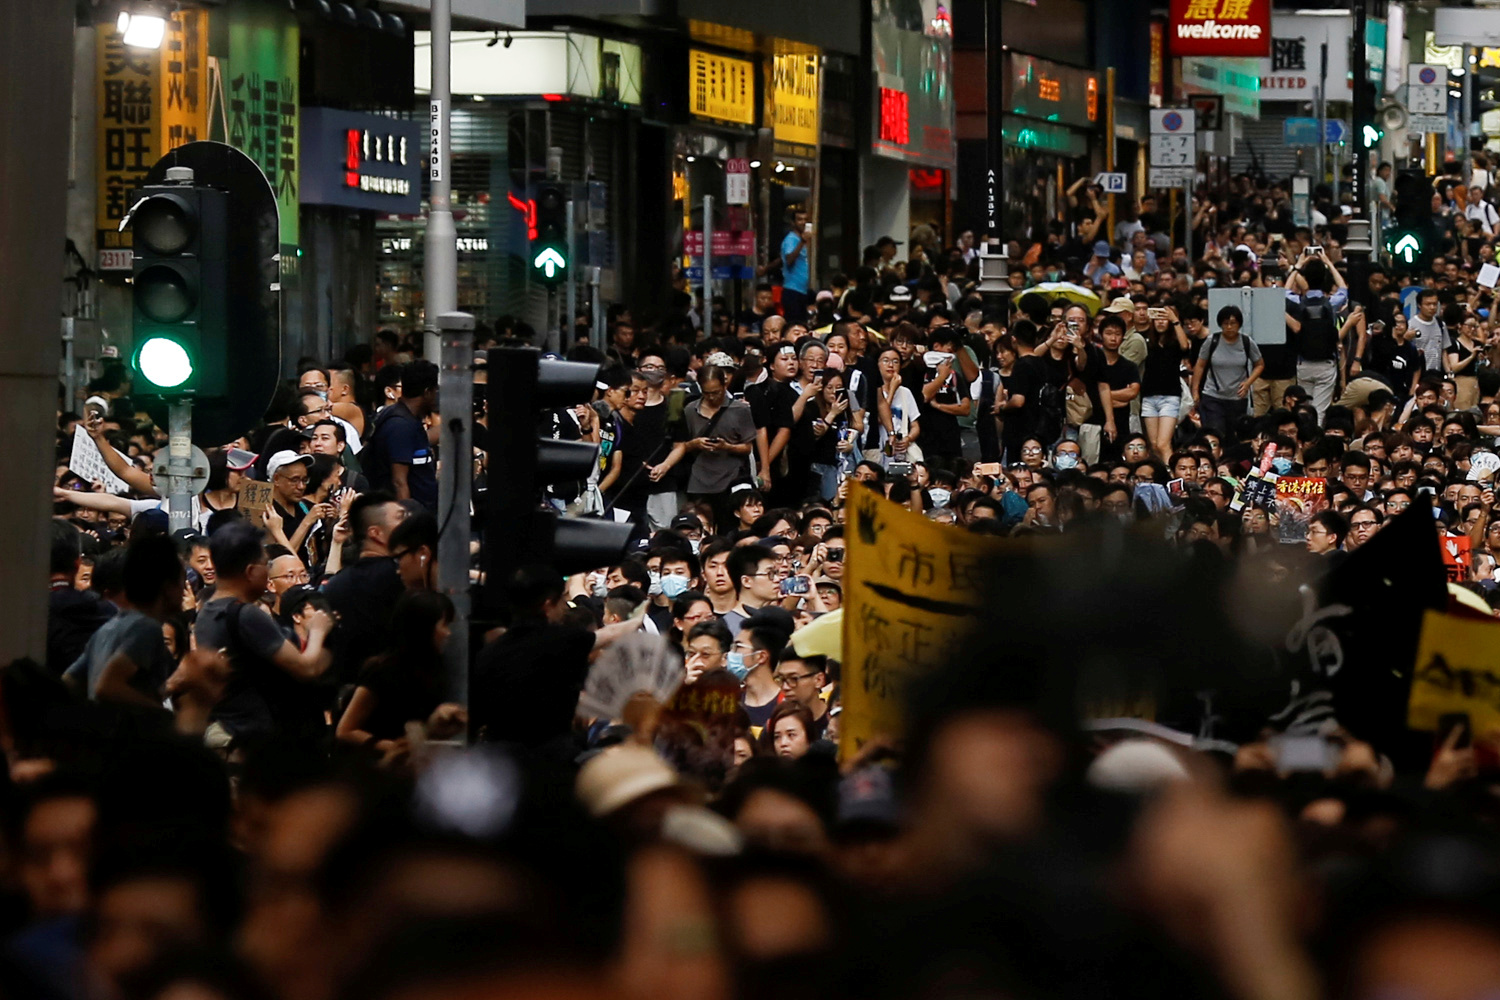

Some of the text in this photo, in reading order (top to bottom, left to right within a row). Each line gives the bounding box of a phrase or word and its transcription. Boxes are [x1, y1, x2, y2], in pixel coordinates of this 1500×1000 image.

[1177, 20, 1262, 39] wellcome
[431, 105, 439, 177] BF 0440 B
